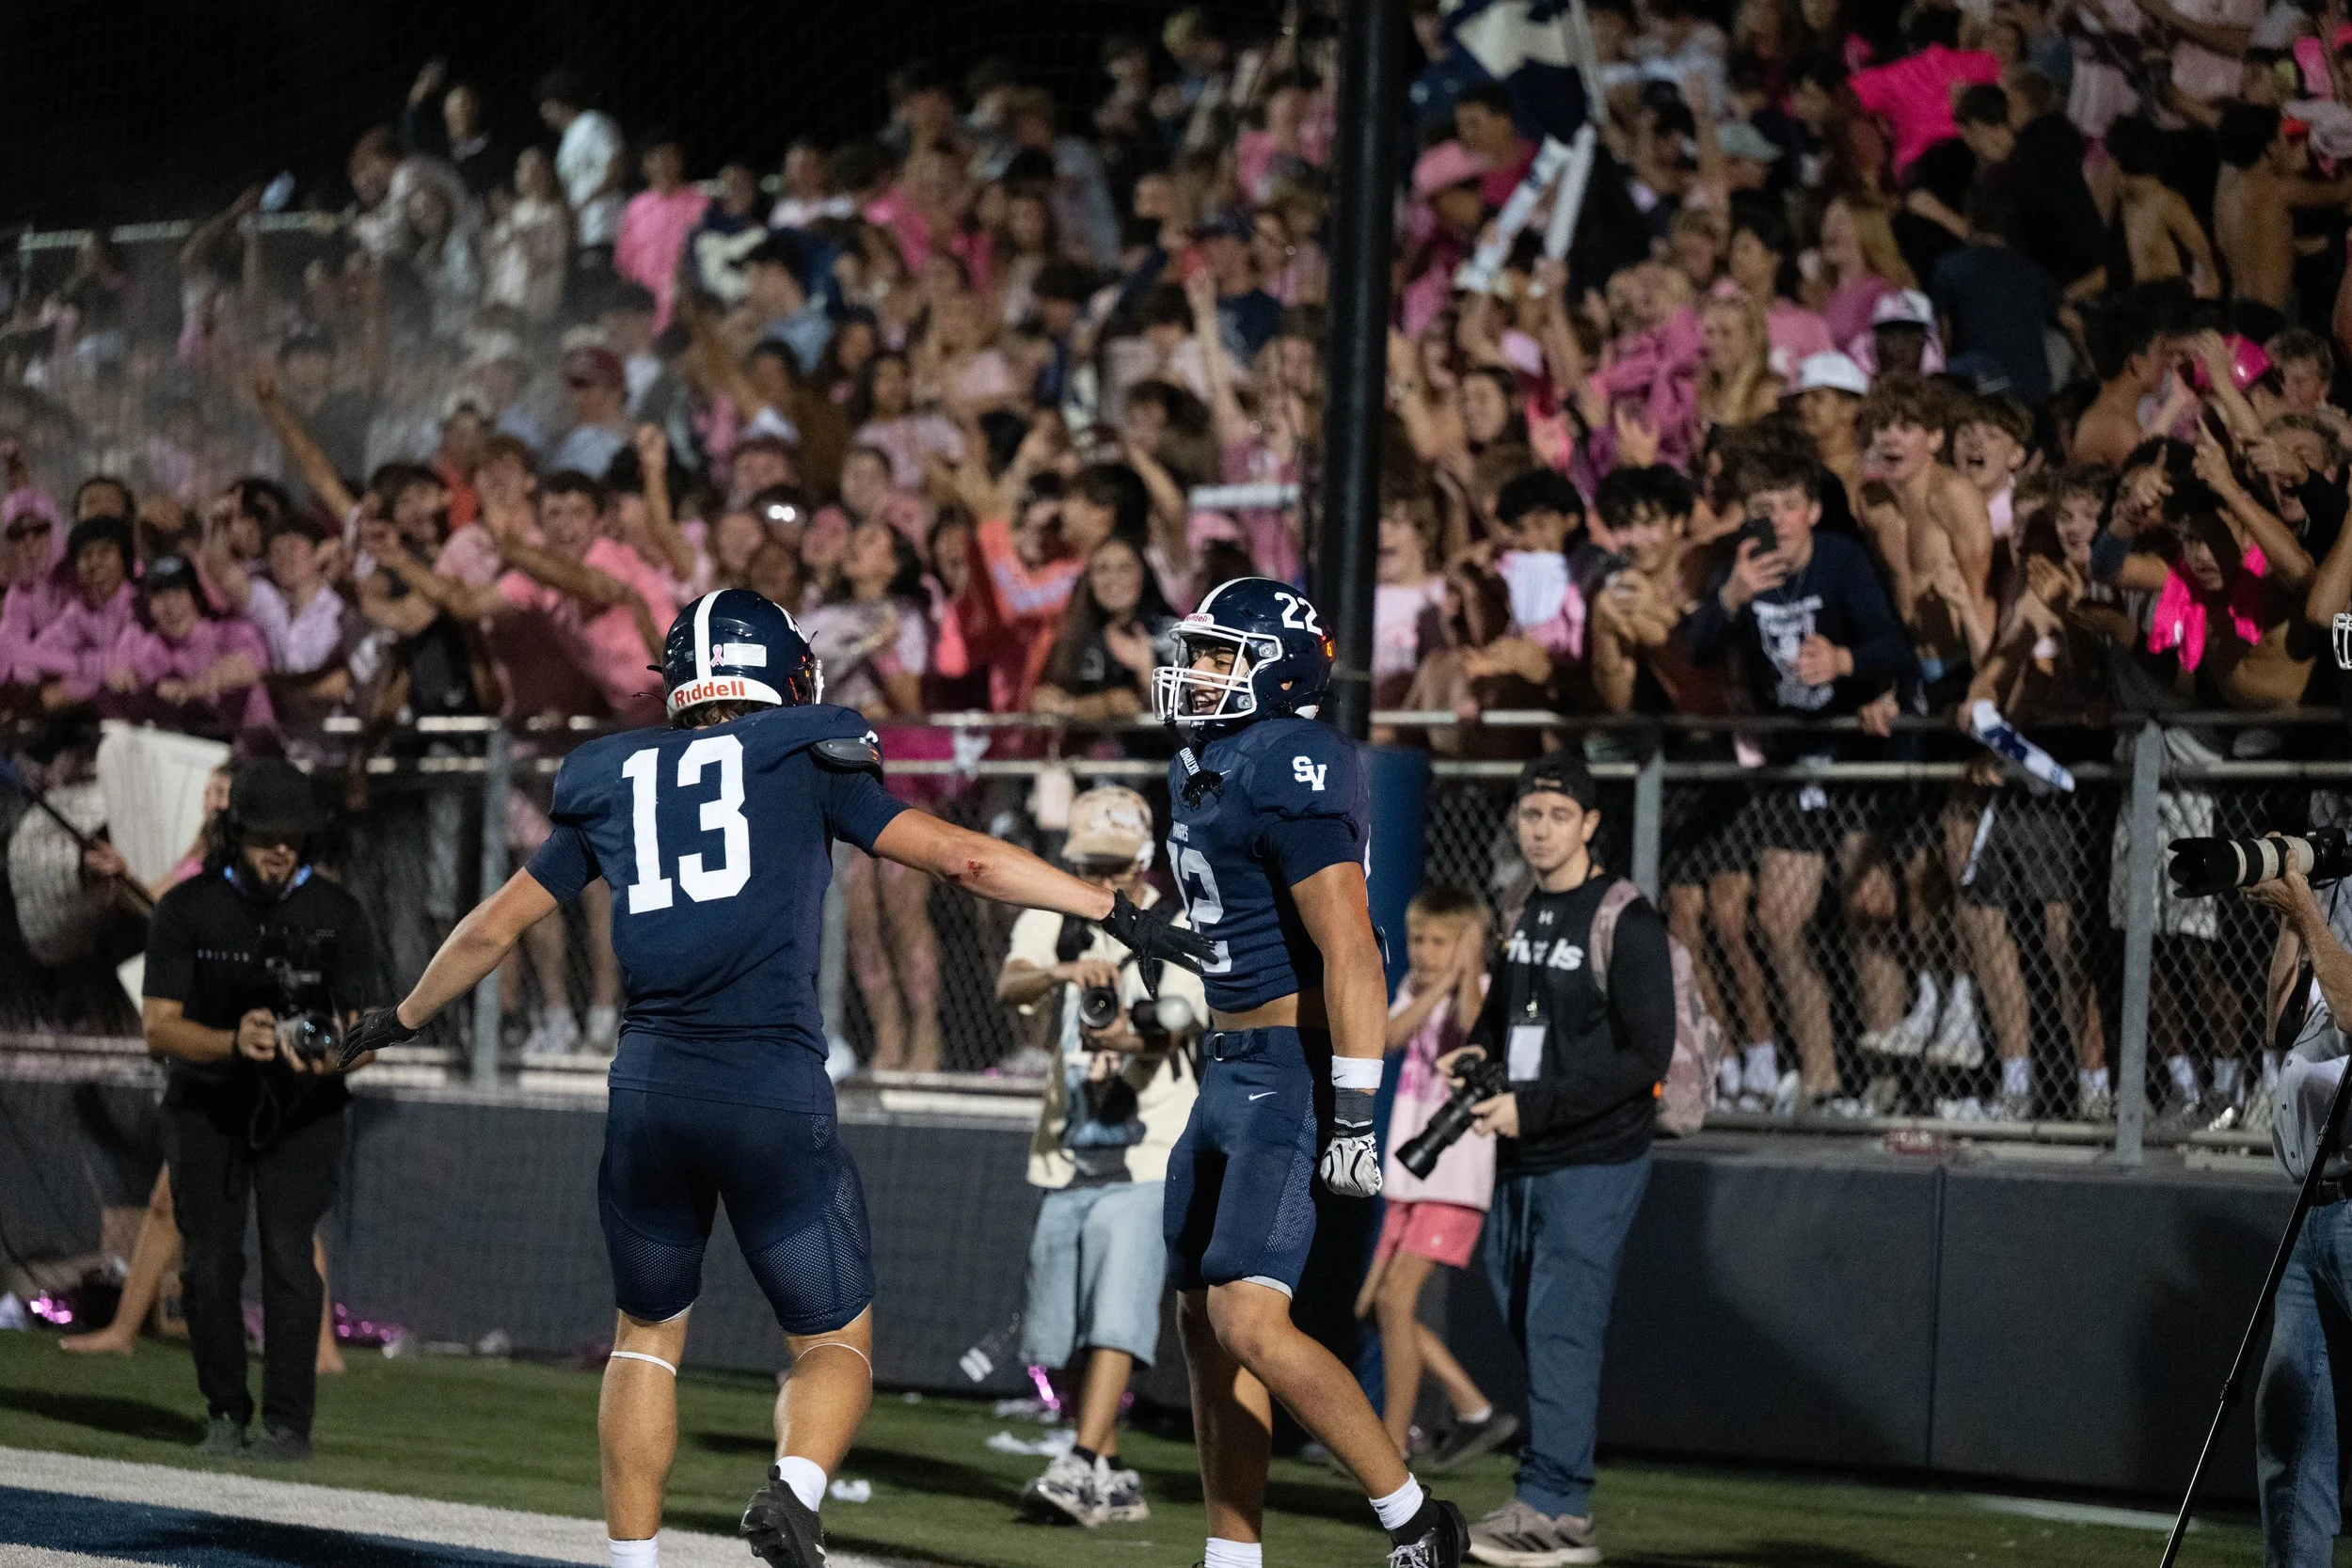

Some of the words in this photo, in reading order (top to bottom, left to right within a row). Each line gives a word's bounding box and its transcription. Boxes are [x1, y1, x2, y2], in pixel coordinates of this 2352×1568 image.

[1274, 592, 1323, 636] 22
[675, 681, 745, 707] Riddell
[1292, 755, 1327, 791] SV
[622, 734, 751, 914] 13
